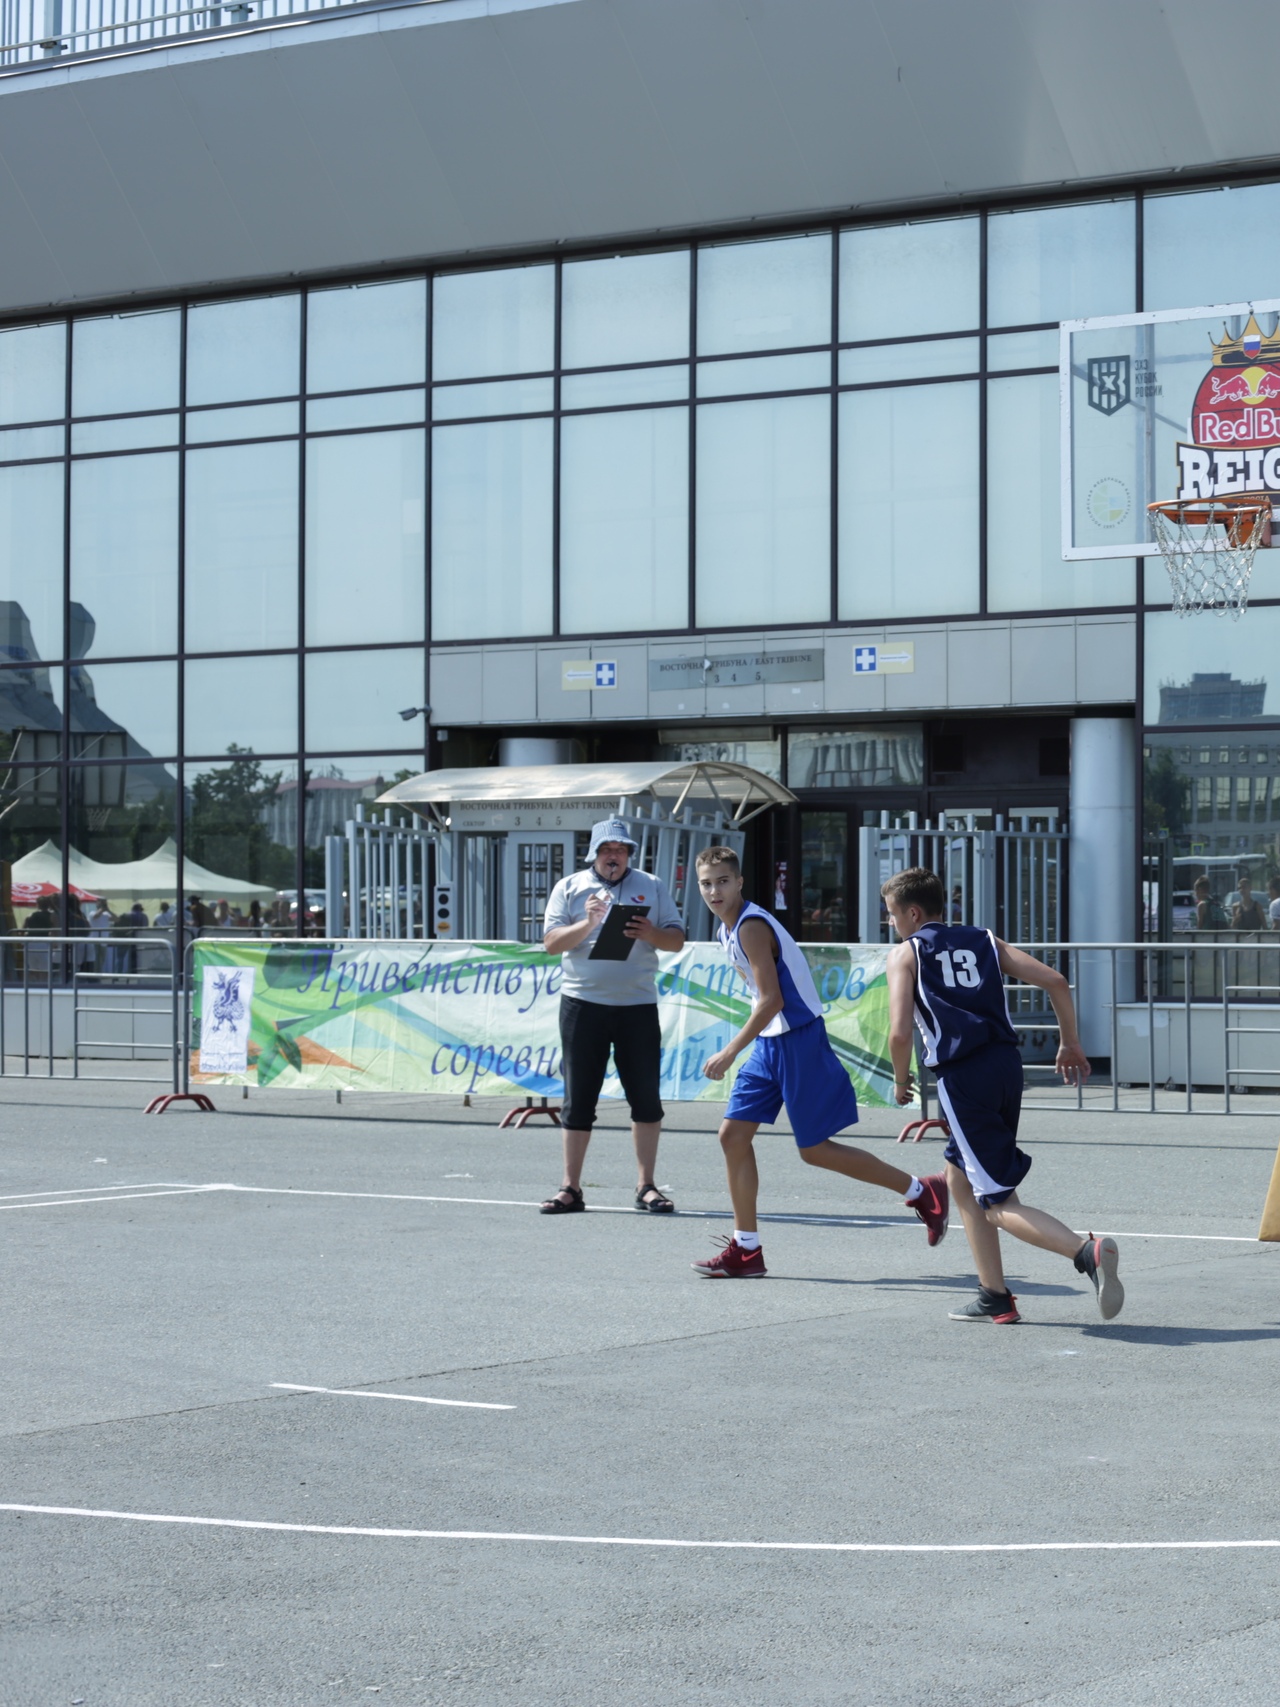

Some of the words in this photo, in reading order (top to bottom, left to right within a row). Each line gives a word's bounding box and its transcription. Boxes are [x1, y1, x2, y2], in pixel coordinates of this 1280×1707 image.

[1135, 372, 1157, 384] КУБОК
[1135, 385, 1163, 398] РОССИИ
[1200, 408, 1253, 443] Red
[660, 662, 707, 672] ВОСТОЧНА
[711, 659, 748, 669] ТРИБУНА
[755, 656, 775, 665] EAST
[776, 654, 812, 664] TRIBUNE
[714, 674, 720, 683] 3
[731, 673, 737, 682] 4
[755, 671, 761, 680] 5
[460, 802, 511, 811] ВОСТОЧНАЯ
[513, 802, 553, 810] ТРИБУНА
[560, 801, 580, 810] EAST
[515, 816, 521, 826] 3
[535, 816, 542, 826] 4
[556, 816, 561, 826] 5
[935, 949, 980, 988] 13
[297, 945, 563, 1014] Приветствуе
